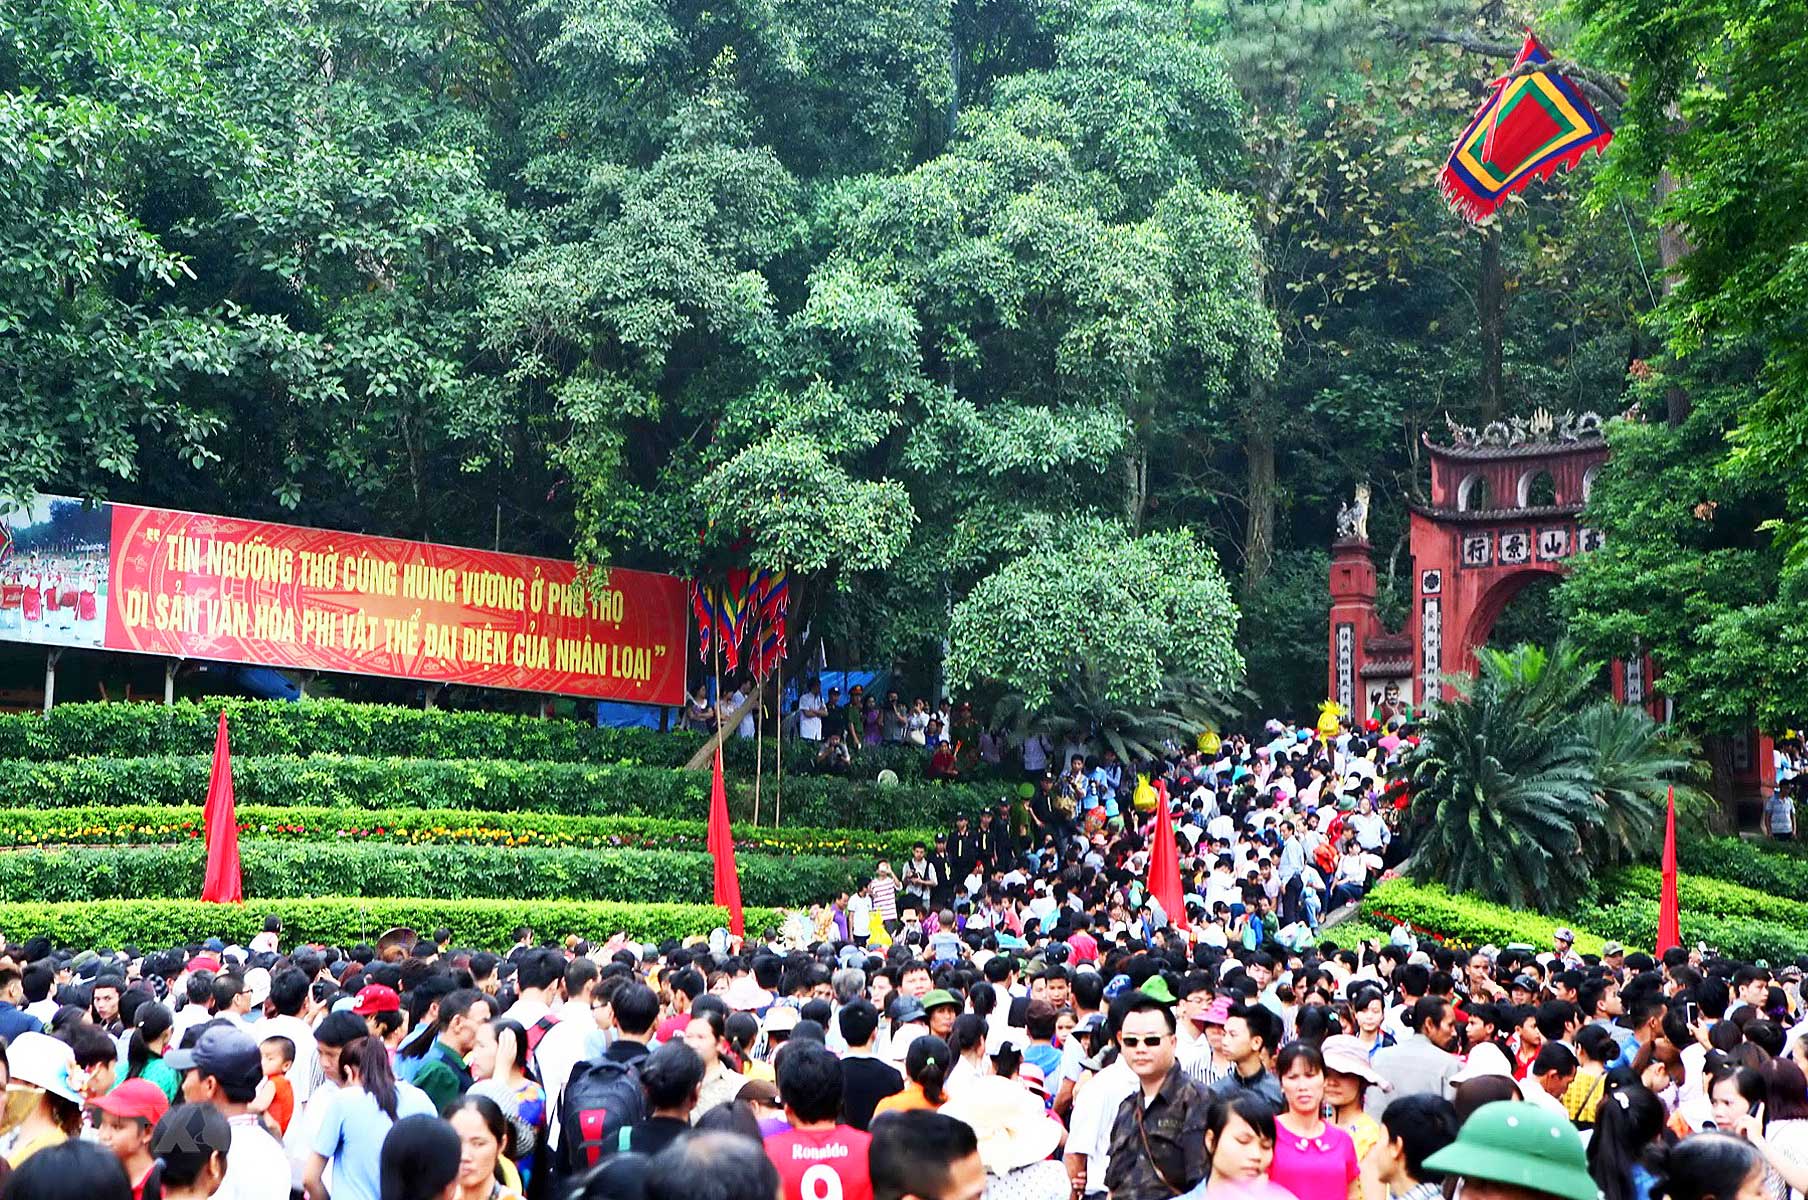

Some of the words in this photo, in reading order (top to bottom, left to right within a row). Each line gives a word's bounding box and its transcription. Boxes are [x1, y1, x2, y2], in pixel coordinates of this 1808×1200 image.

[206, 536, 293, 585] NGƯỠNG
[300, 545, 339, 588] THỜ
[343, 554, 397, 596] CÚNG
[403, 559, 456, 602] HÙNG
[462, 570, 524, 611] VƯƠNG
[530, 567, 544, 613] Ở
[126, 589, 149, 629] DI
[156, 581, 200, 633] SẢN
[206, 593, 248, 638] VĂN
[254, 600, 296, 642] HÓA
[302, 609, 336, 647] PHI
[342, 610, 378, 658] VẬT
[385, 608, 421, 654] THỂ
[424, 623, 457, 666] ĐẠI
[462, 622, 507, 671] DIỆN
[513, 621, 550, 669] CỦA
[555, 632, 607, 675] NHÂN
[792, 1142, 848, 1160] Ronaldo
